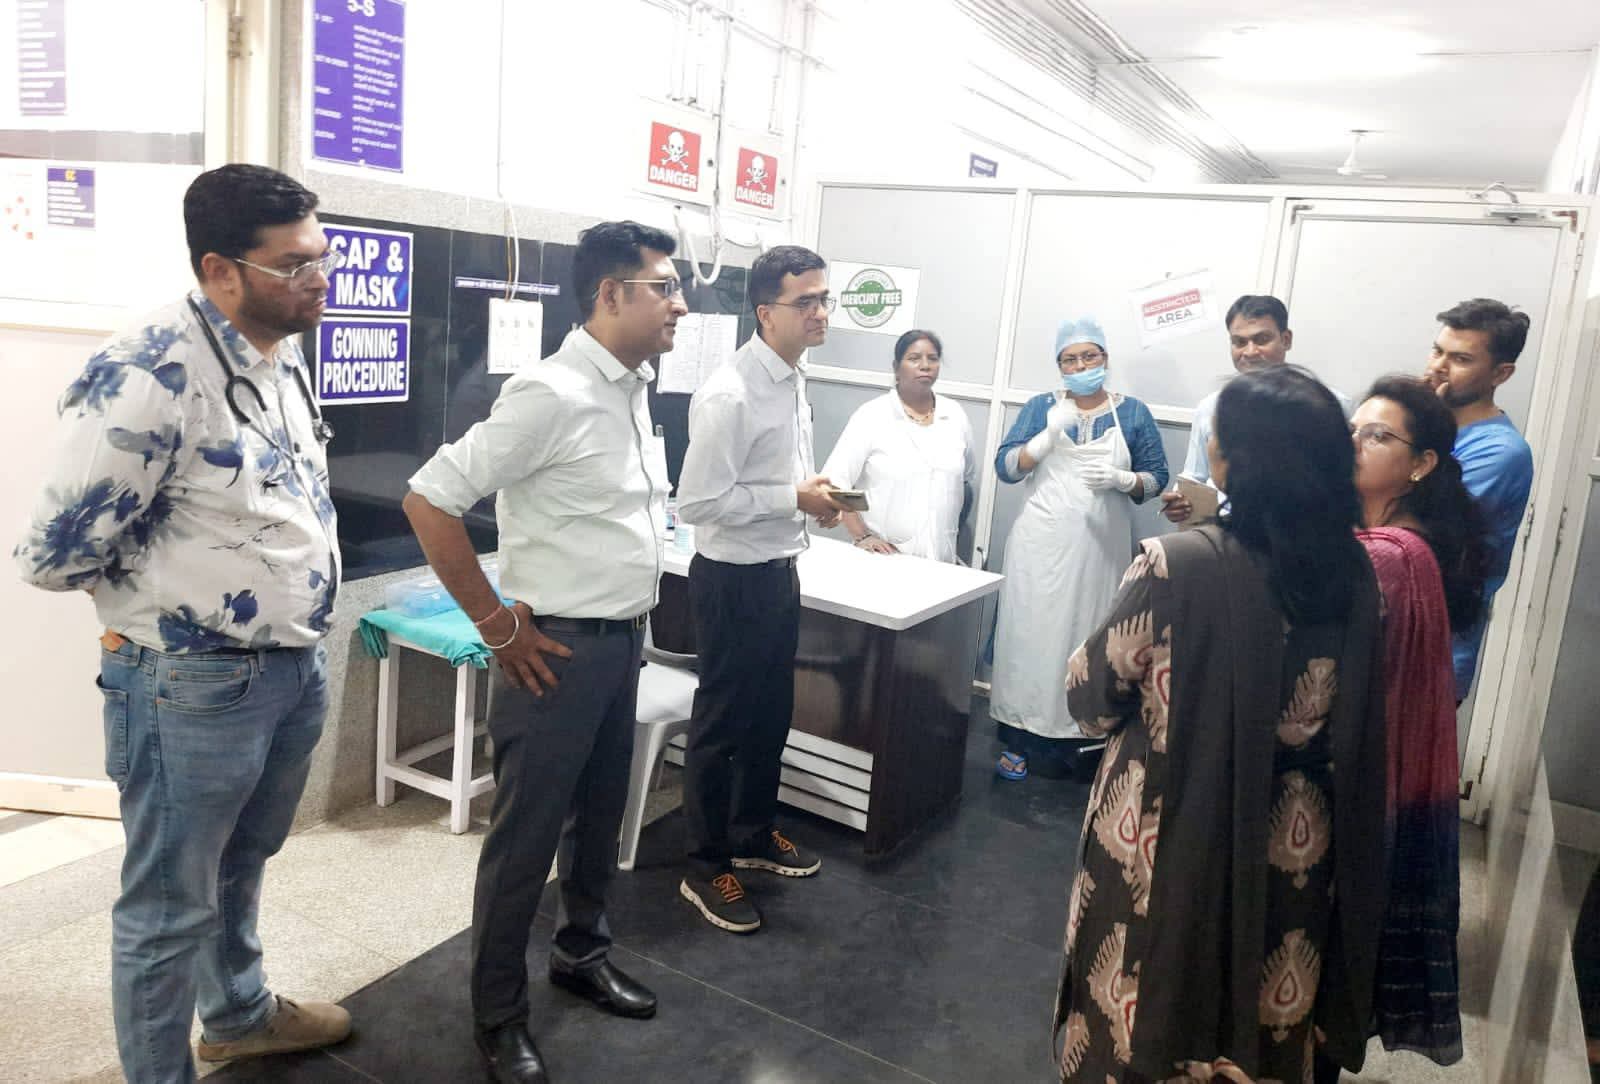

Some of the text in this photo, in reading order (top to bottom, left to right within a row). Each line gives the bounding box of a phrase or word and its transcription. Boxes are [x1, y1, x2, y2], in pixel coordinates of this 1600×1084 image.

[649, 165, 697, 190] DANGER
[736, 185, 773, 207] DANGER
[330, 234, 404, 273] CAP &
[335, 273, 398, 307] MASK
[841, 291, 901, 305] MERCURY FREE
[1157, 308, 1192, 325] AREA
[331, 327, 398, 360] GOWNING
[322, 360, 405, 394] PROCEDURE
